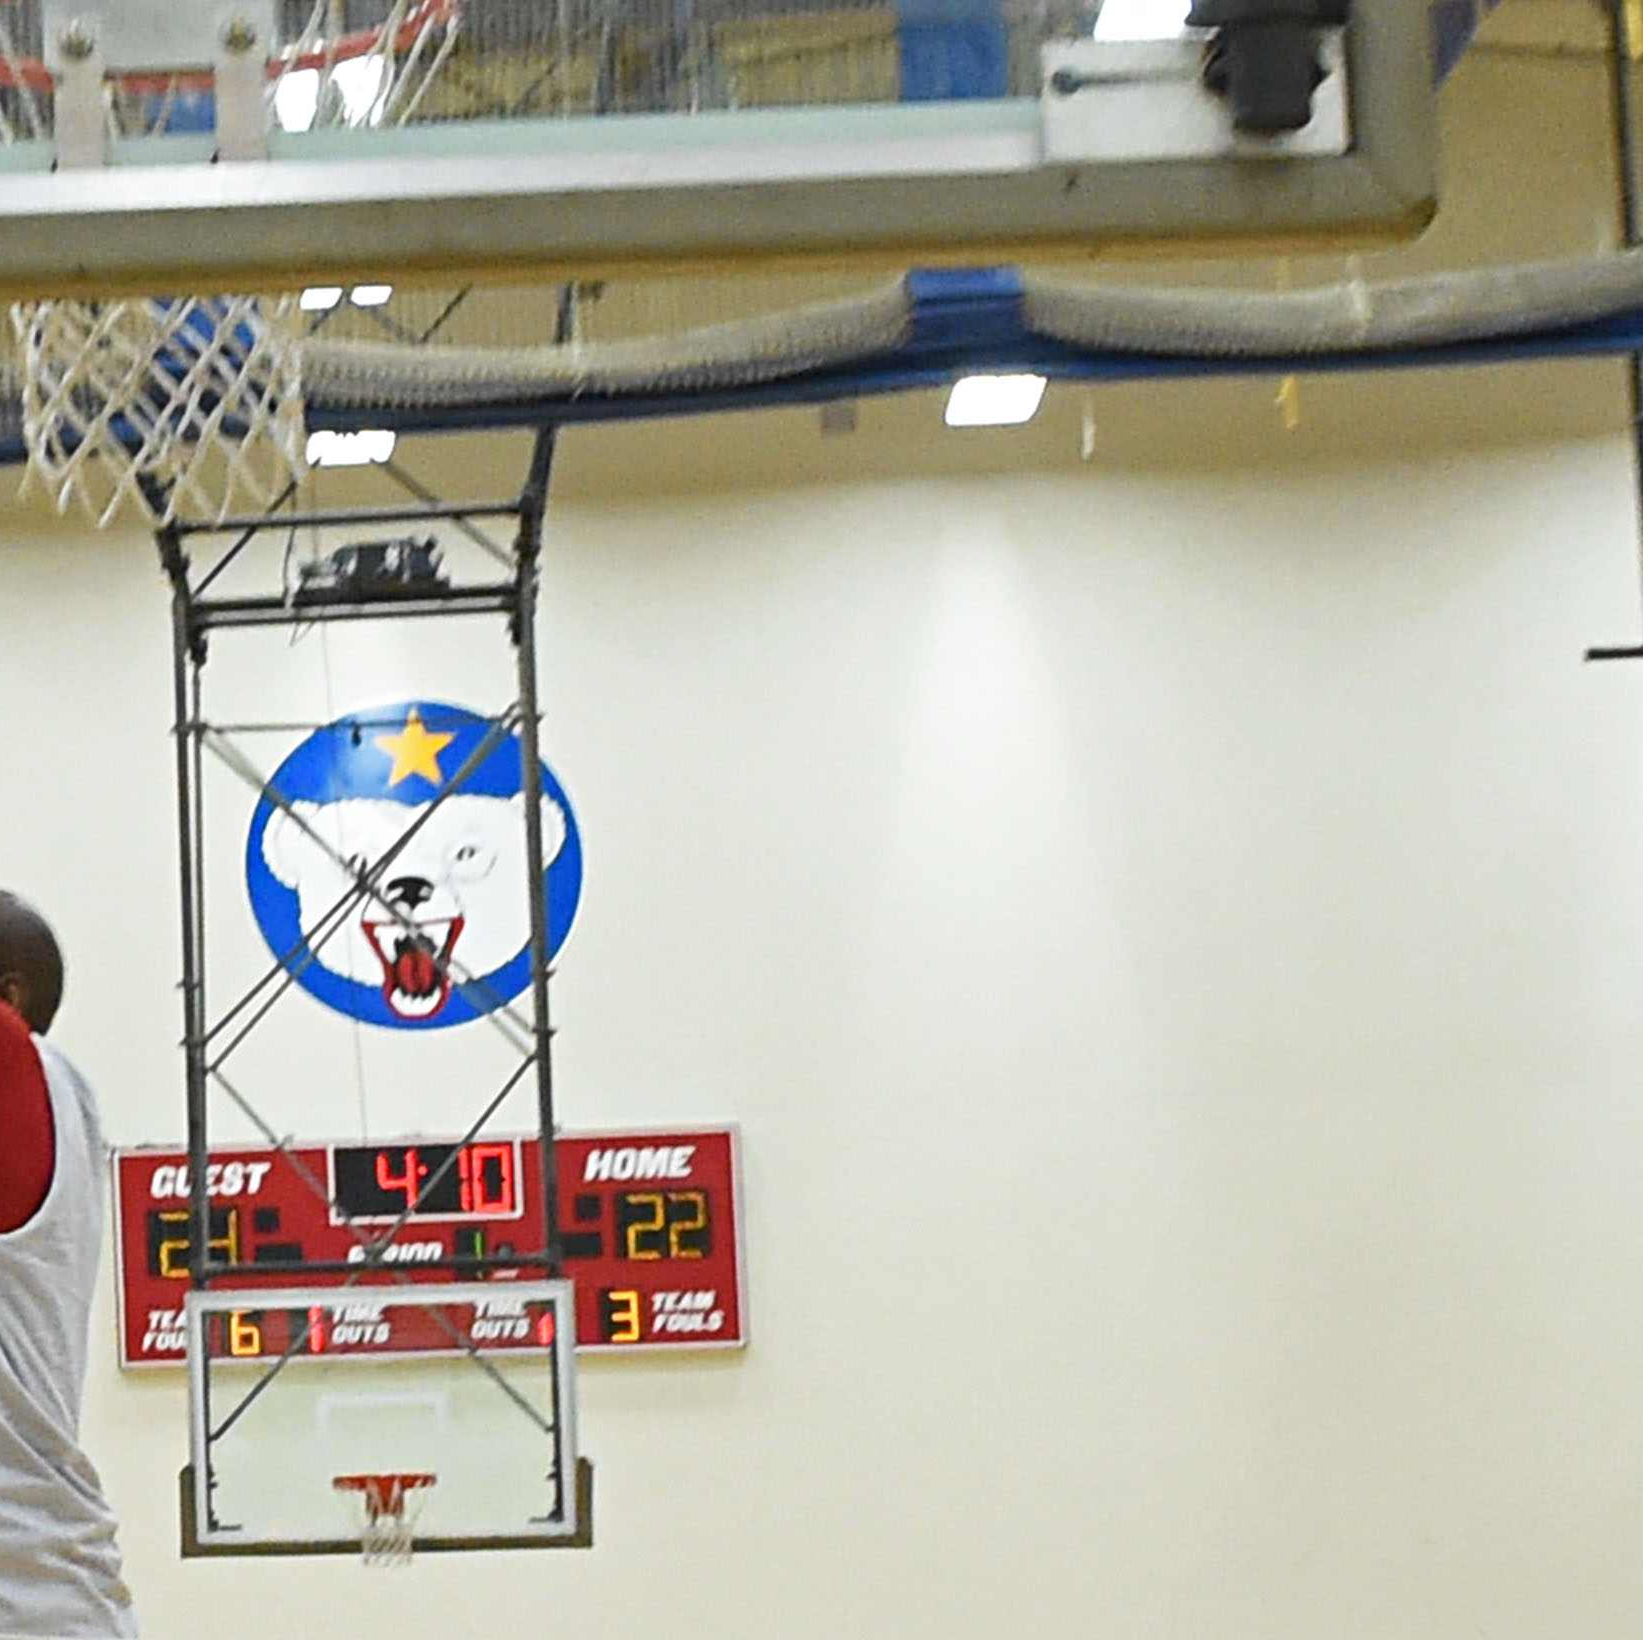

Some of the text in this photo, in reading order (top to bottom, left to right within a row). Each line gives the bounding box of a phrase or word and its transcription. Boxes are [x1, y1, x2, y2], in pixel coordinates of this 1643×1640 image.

[583, 1146, 697, 1182] HOME
[150, 1162, 271, 1198] GUEST
[626, 1190, 707, 1260] 22
[608, 1290, 640, 1341] 3
[651, 1290, 716, 1312] TEAM
[148, 1309, 188, 1331] TEA
[230, 1307, 261, 1356] 6
[332, 1323, 391, 1345] OUTS
[471, 1317, 530, 1339] OUTS
[651, 1311, 725, 1334] FOULS
